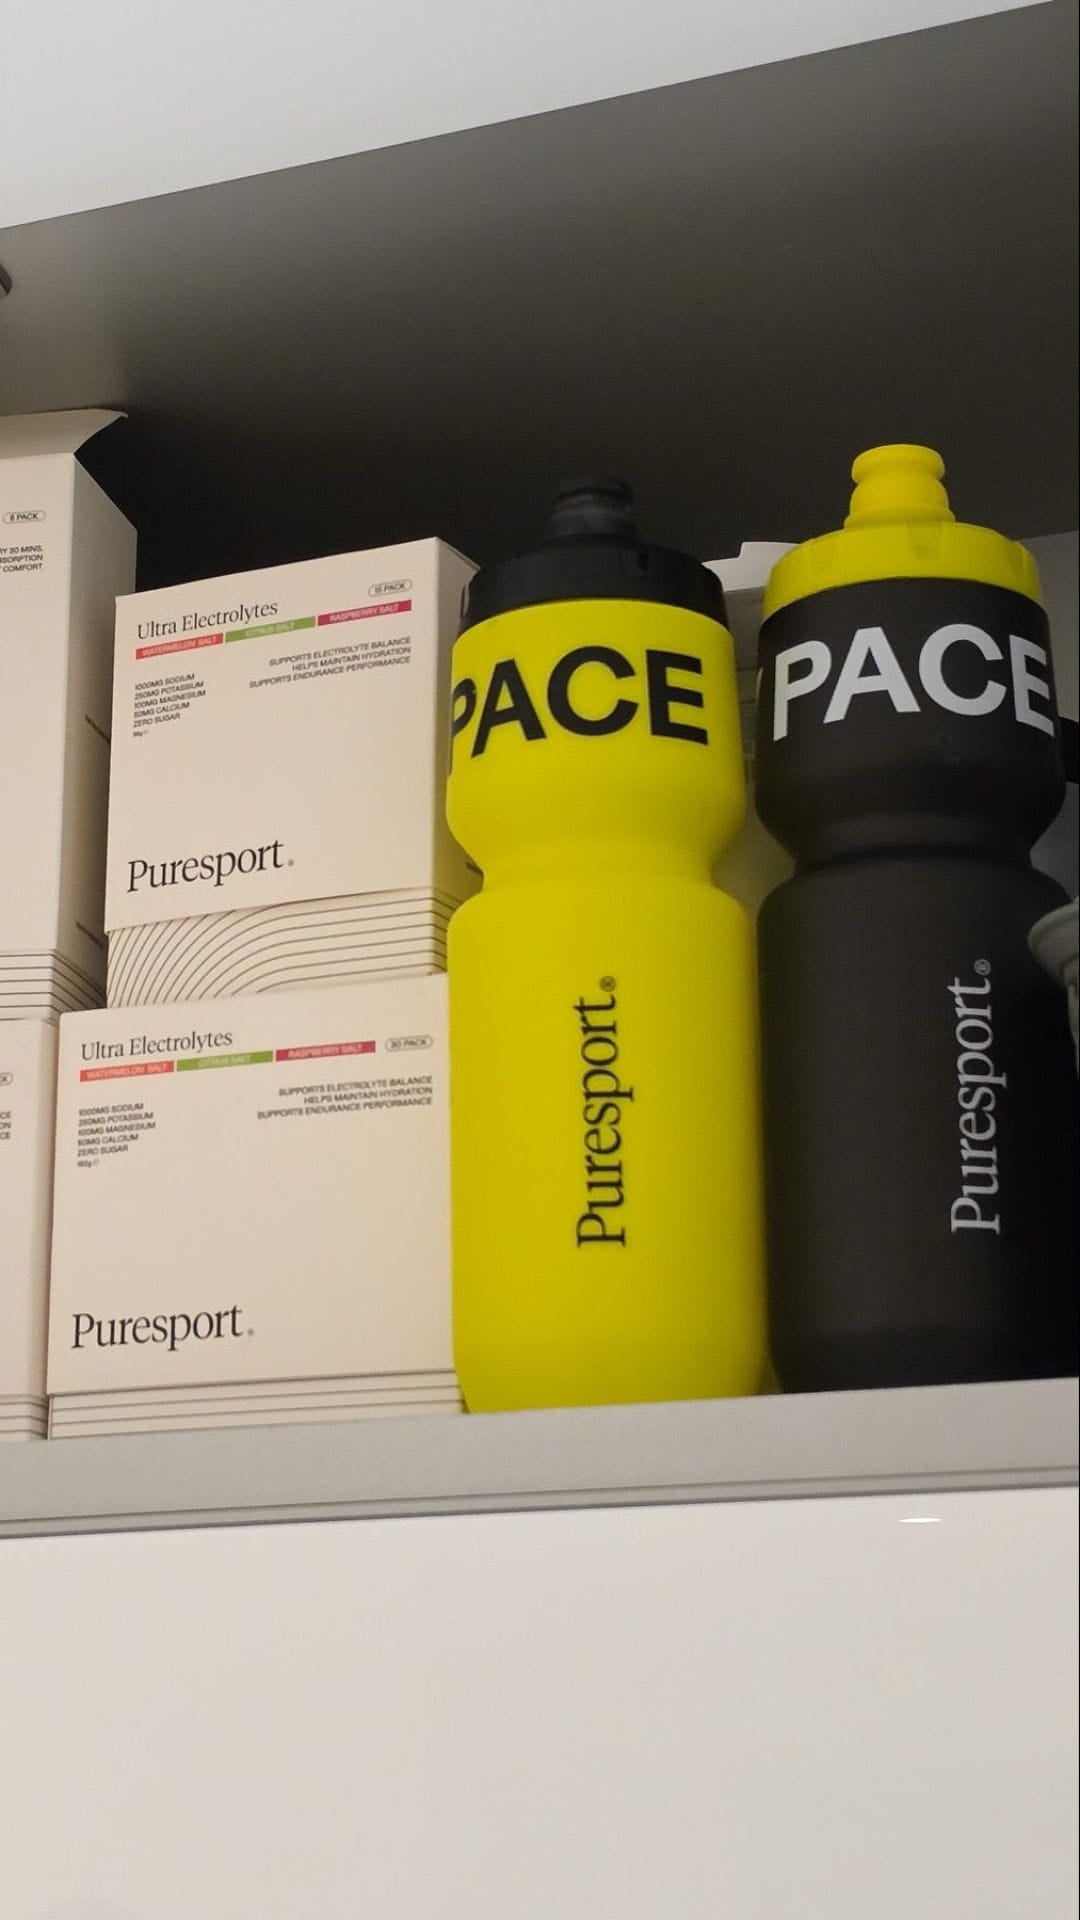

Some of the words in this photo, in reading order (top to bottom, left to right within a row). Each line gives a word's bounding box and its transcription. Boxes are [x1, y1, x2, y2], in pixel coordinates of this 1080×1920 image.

[16, 512, 38, 520] PACK
[0, 554, 43, 563] SORPTION
[2, 563, 43, 573] COMFORT
[384, 583, 405, 592] PACK
[137, 620, 177, 640] Ultra
[182, 601, 278, 632] Electrolytes
[329, 608, 377, 622] RASPBERRY
[378, 603, 400, 614] SALT
[197, 636, 217, 646] SALT
[269, 653, 312, 667] SUPPORTS
[313, 643, 370, 659] ELECTROLYTE
[371, 636, 411, 649] BALANCE
[292, 661, 318, 672] HELPS
[320, 654, 360, 667] MAINTAIN
[361, 647, 412, 660] HYDRATION
[249, 675, 291, 688] SUPPORTS
[293, 667, 345, 681] ENDURANCE
[346, 656, 411, 672] PERFORMANCE
[135, 679, 163, 691] 1000MG
[165, 673, 195, 685] SODIUM
[135, 689, 159, 700] 250MG
[161, 681, 205, 695] POTASSIUM
[773, 623, 1055, 741] PACE
[134, 698, 158, 709] 100MG
[160, 690, 206, 704] MAGNESIUM
[451, 645, 709, 770] PACE
[134, 708, 155, 719] 50MG
[156, 702, 190, 715] CALCIUM
[133, 718, 153, 728] ZERO
[155, 712, 181, 724] SUGAR
[81, 1041, 124, 1061] Ultra
[129, 1030, 233, 1056] Electrolytes
[403, 1038, 427, 1047] PACK
[86, 1066, 145, 1080] WATERMELON
[146, 1063, 167, 1073] SALT
[279, 1085, 325, 1097] SUPPORTS
[327, 1079, 387, 1093] ELECTROLYTE
[389, 1075, 432, 1087] BALANCE
[304, 1094, 332, 1105] HELPS
[334, 1091, 378, 1102] MAINTAIN
[379, 1086, 433, 1098] HYDRATION
[78, 1106, 110, 1116] 1000MG
[111, 1103, 144, 1114] SODIUM
[257, 1107, 303, 1119] SUPPORTS
[305, 1102, 361, 1116] ENDURANCE
[363, 1097, 432, 1111] PERFORMANCE
[107, 1112, 154, 1123] POTASSIUM
[78, 1126, 104, 1136] 100MG
[106, 1122, 156, 1134] MAGNESIUM
[102, 1134, 139, 1145] CALCIUM
[77, 1147, 99, 1157] ZERO
[100, 1145, 128, 1155] SUGAR
